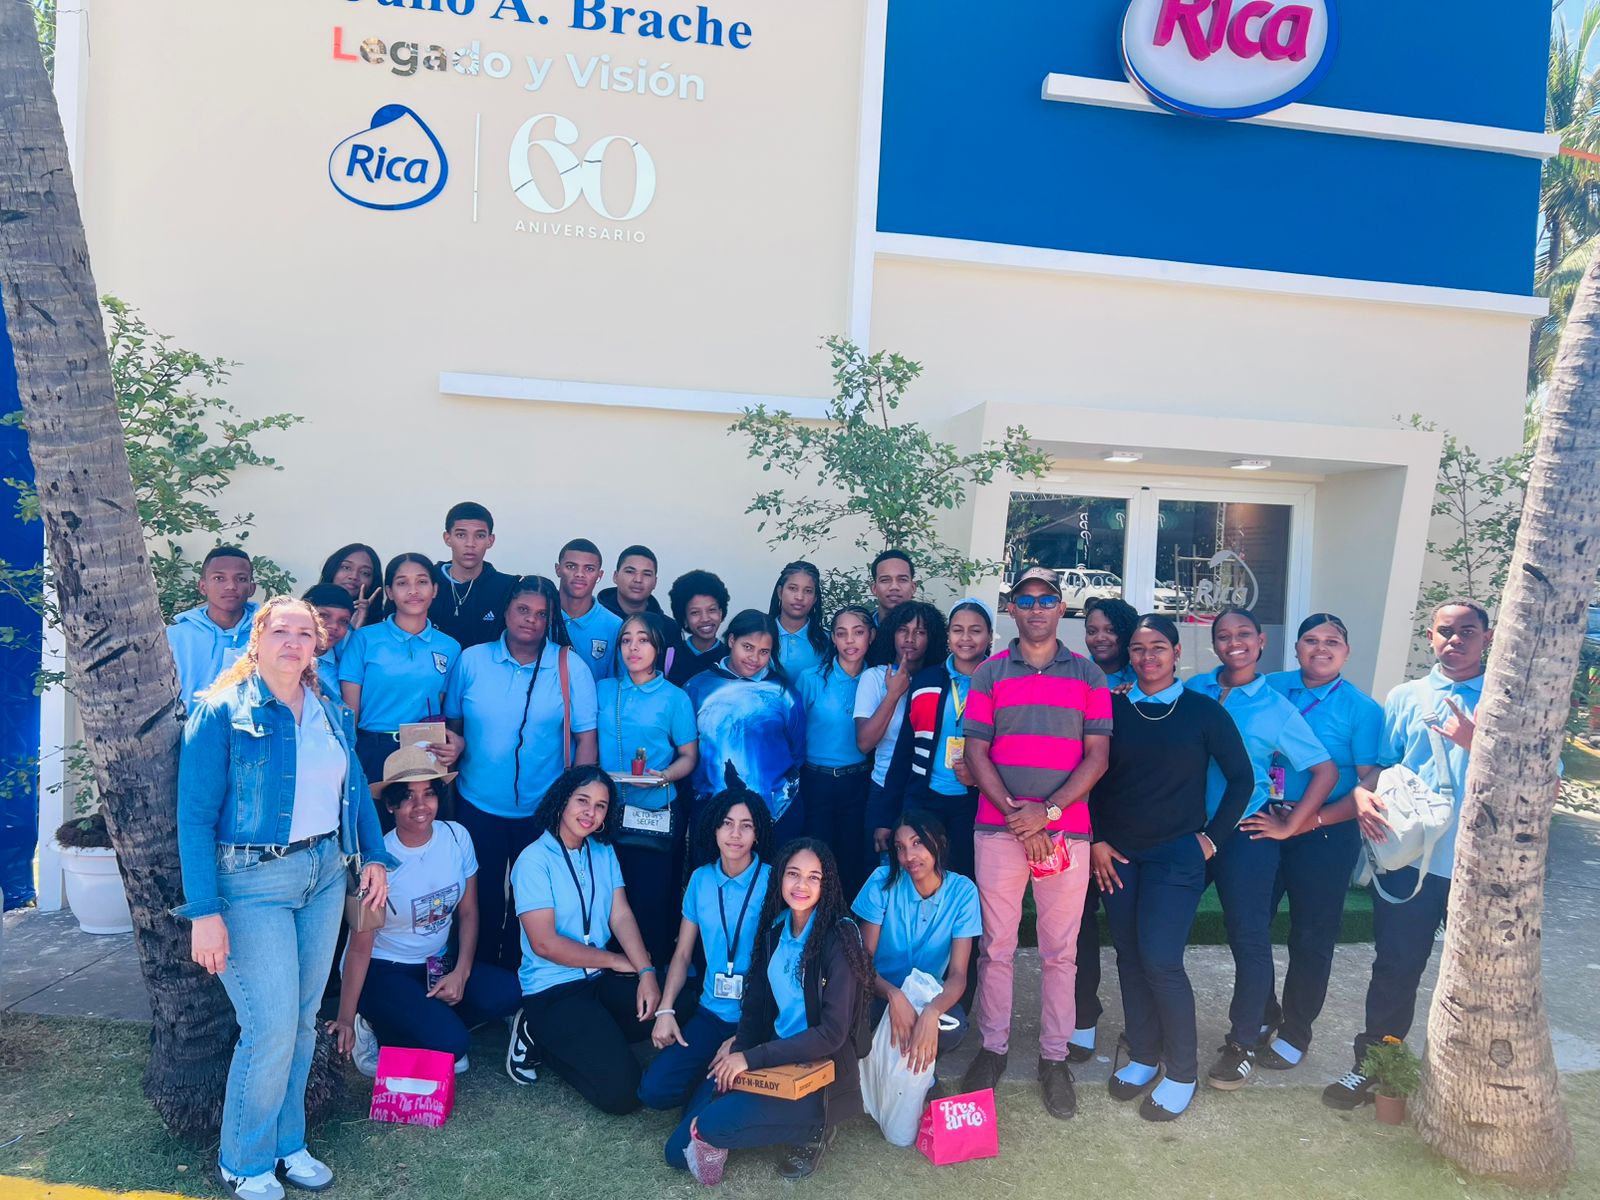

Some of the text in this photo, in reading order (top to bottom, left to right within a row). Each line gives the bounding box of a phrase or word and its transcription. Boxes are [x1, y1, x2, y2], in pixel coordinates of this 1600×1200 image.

[568, 0, 753, 50] Brache
[1152, 0, 1313, 62] Rica
[332, 26, 706, 101] Legado y Visión
[346, 143, 429, 185] Rica
[508, 113, 656, 221] 60
[515, 219, 647, 243] ANIVERSARIO
[1194, 578, 1248, 609] Rica
[734, 1077, 779, 1091] OT-N-READY
[939, 1100, 976, 1118] Fres
[945, 1111, 983, 1130] arte
